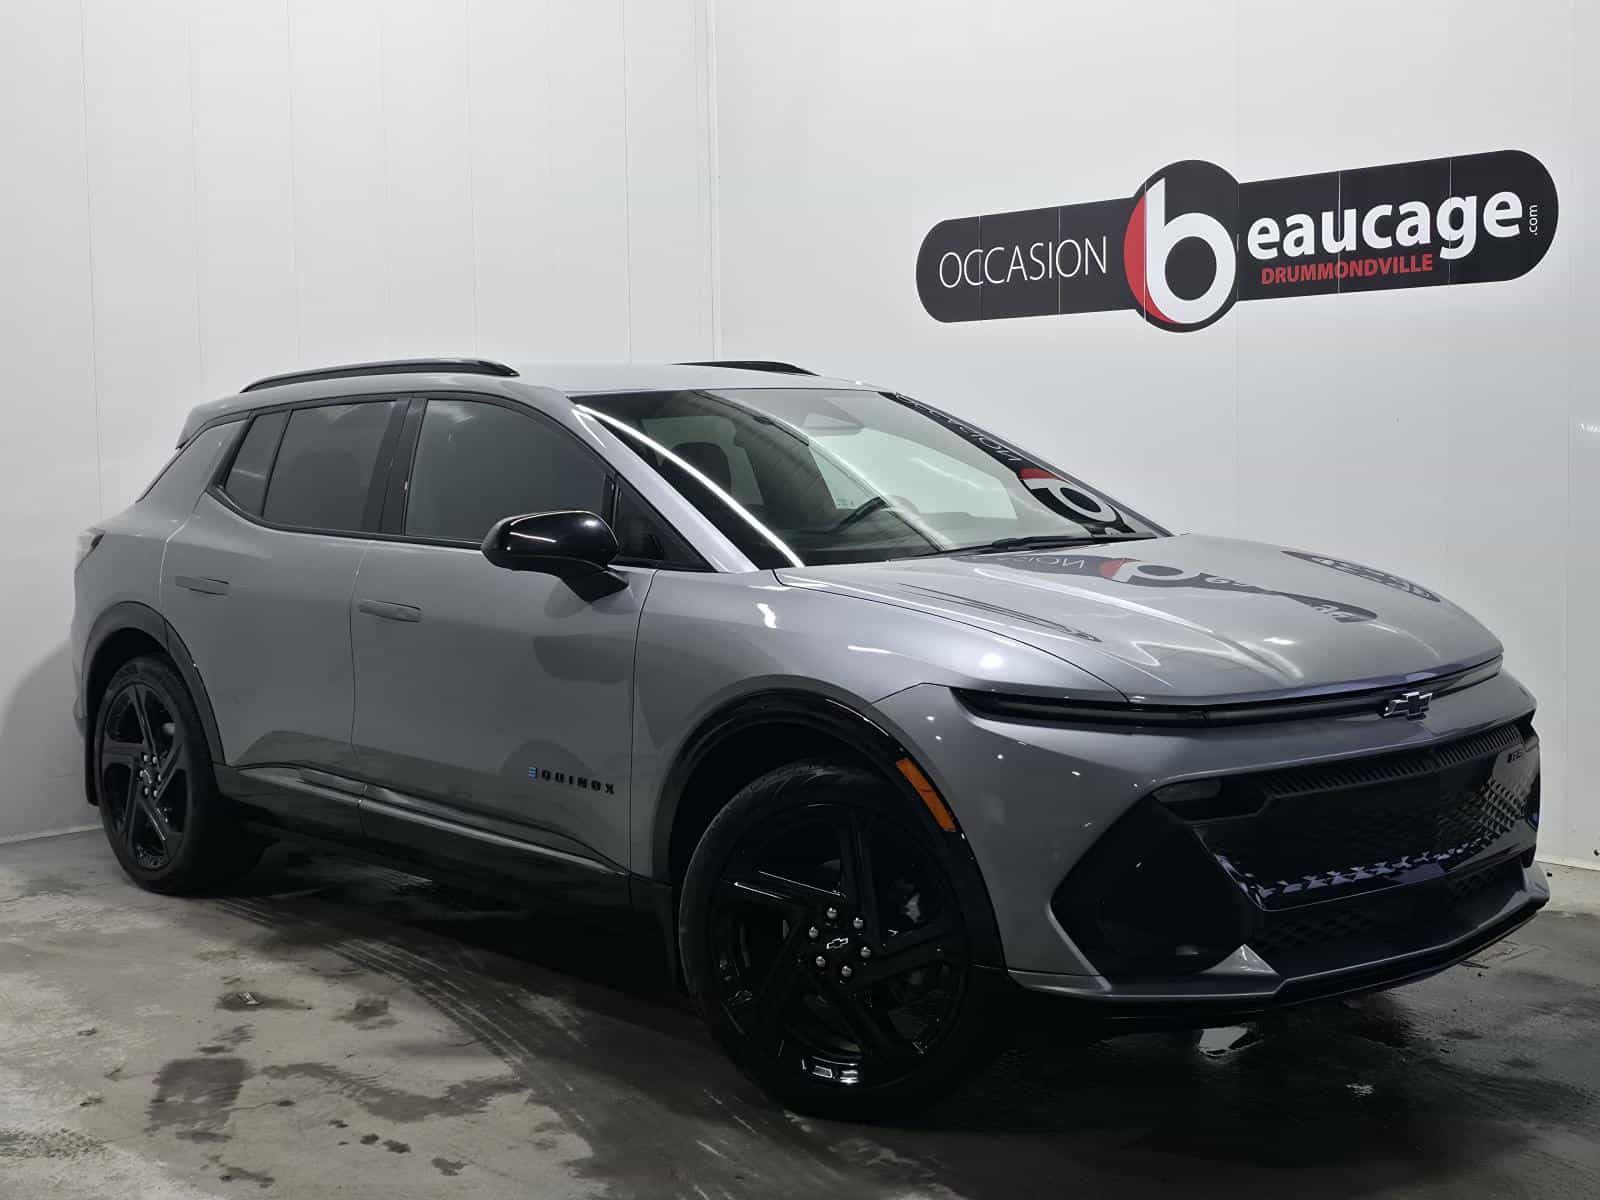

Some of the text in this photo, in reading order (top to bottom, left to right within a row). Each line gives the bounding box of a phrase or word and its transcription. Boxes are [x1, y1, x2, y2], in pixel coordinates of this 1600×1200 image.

[939, 235, 1107, 288] OCCASION
[1528, 204, 1539, 235] .com
[1260, 253, 1433, 285] DRUMMONDVILLE
